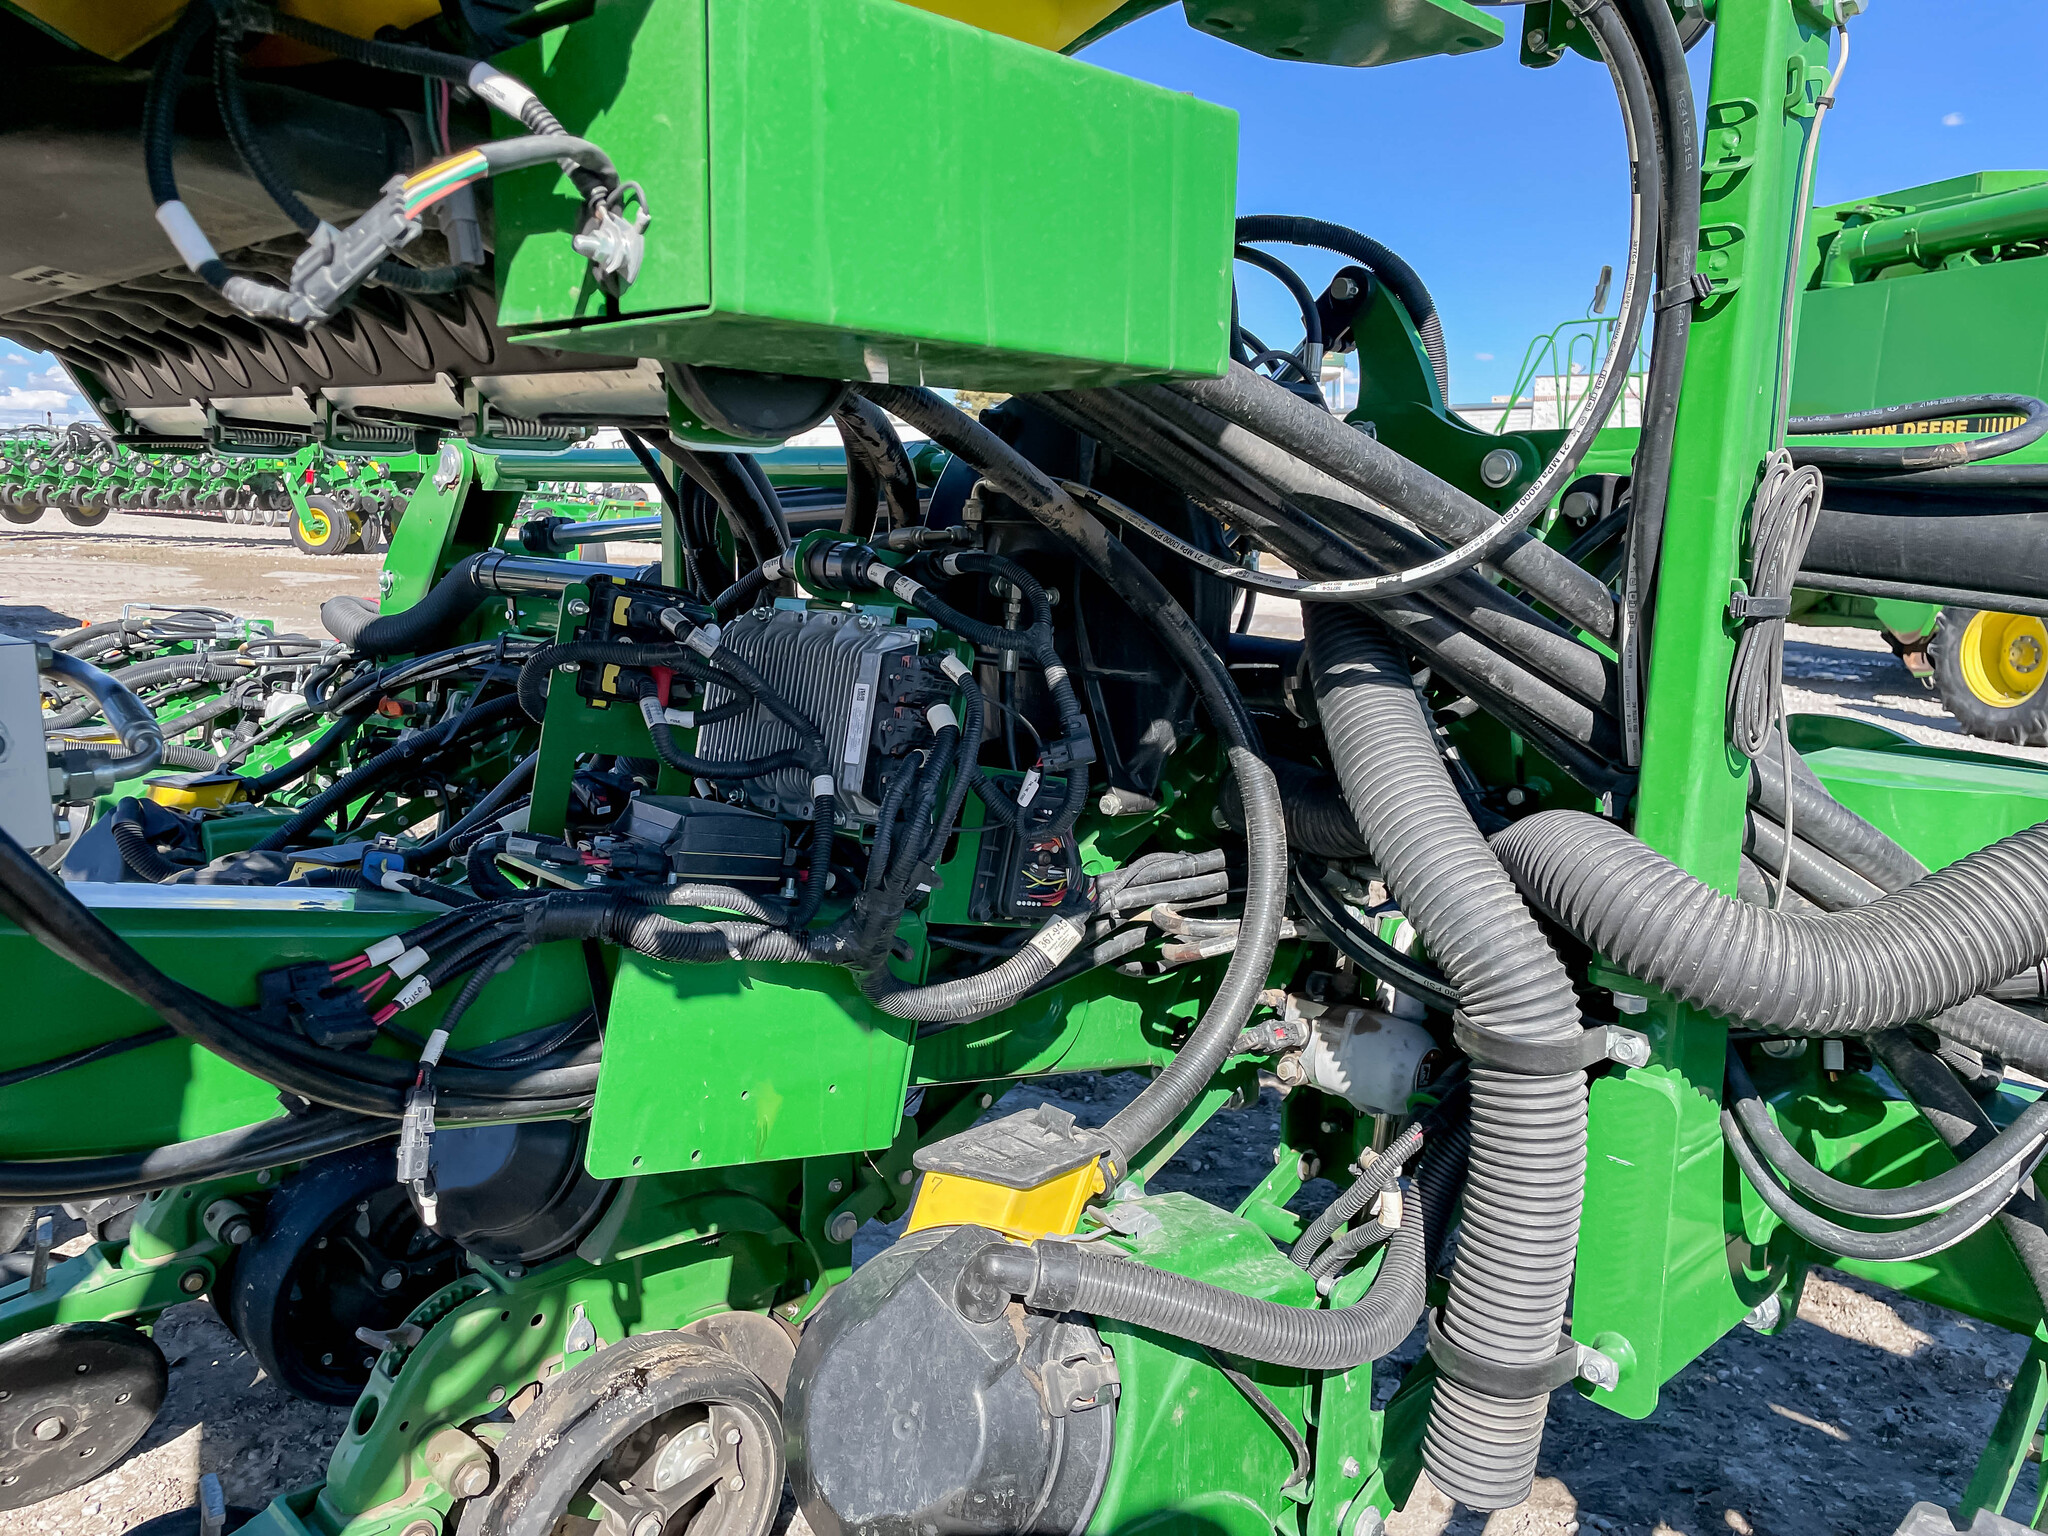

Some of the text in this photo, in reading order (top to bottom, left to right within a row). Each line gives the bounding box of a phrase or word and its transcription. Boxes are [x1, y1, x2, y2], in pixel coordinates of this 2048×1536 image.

[1903, 419, 1968, 435] DEERE
[1559, 443, 1570, 456] 21
[1542, 457, 1561, 480] MPa
[1520, 480, 1543, 509] (3000
[1500, 507, 1520, 526] PSI)
[1150, 527, 1204, 561] 21 MPa (3000 PSI)
[1039, 919, 1068, 949] 367-945
[402, 978, 430, 1008] Fuse 2
[1423, 979, 1443, 995] PSI)
[931, 1176, 944, 1194] 7
